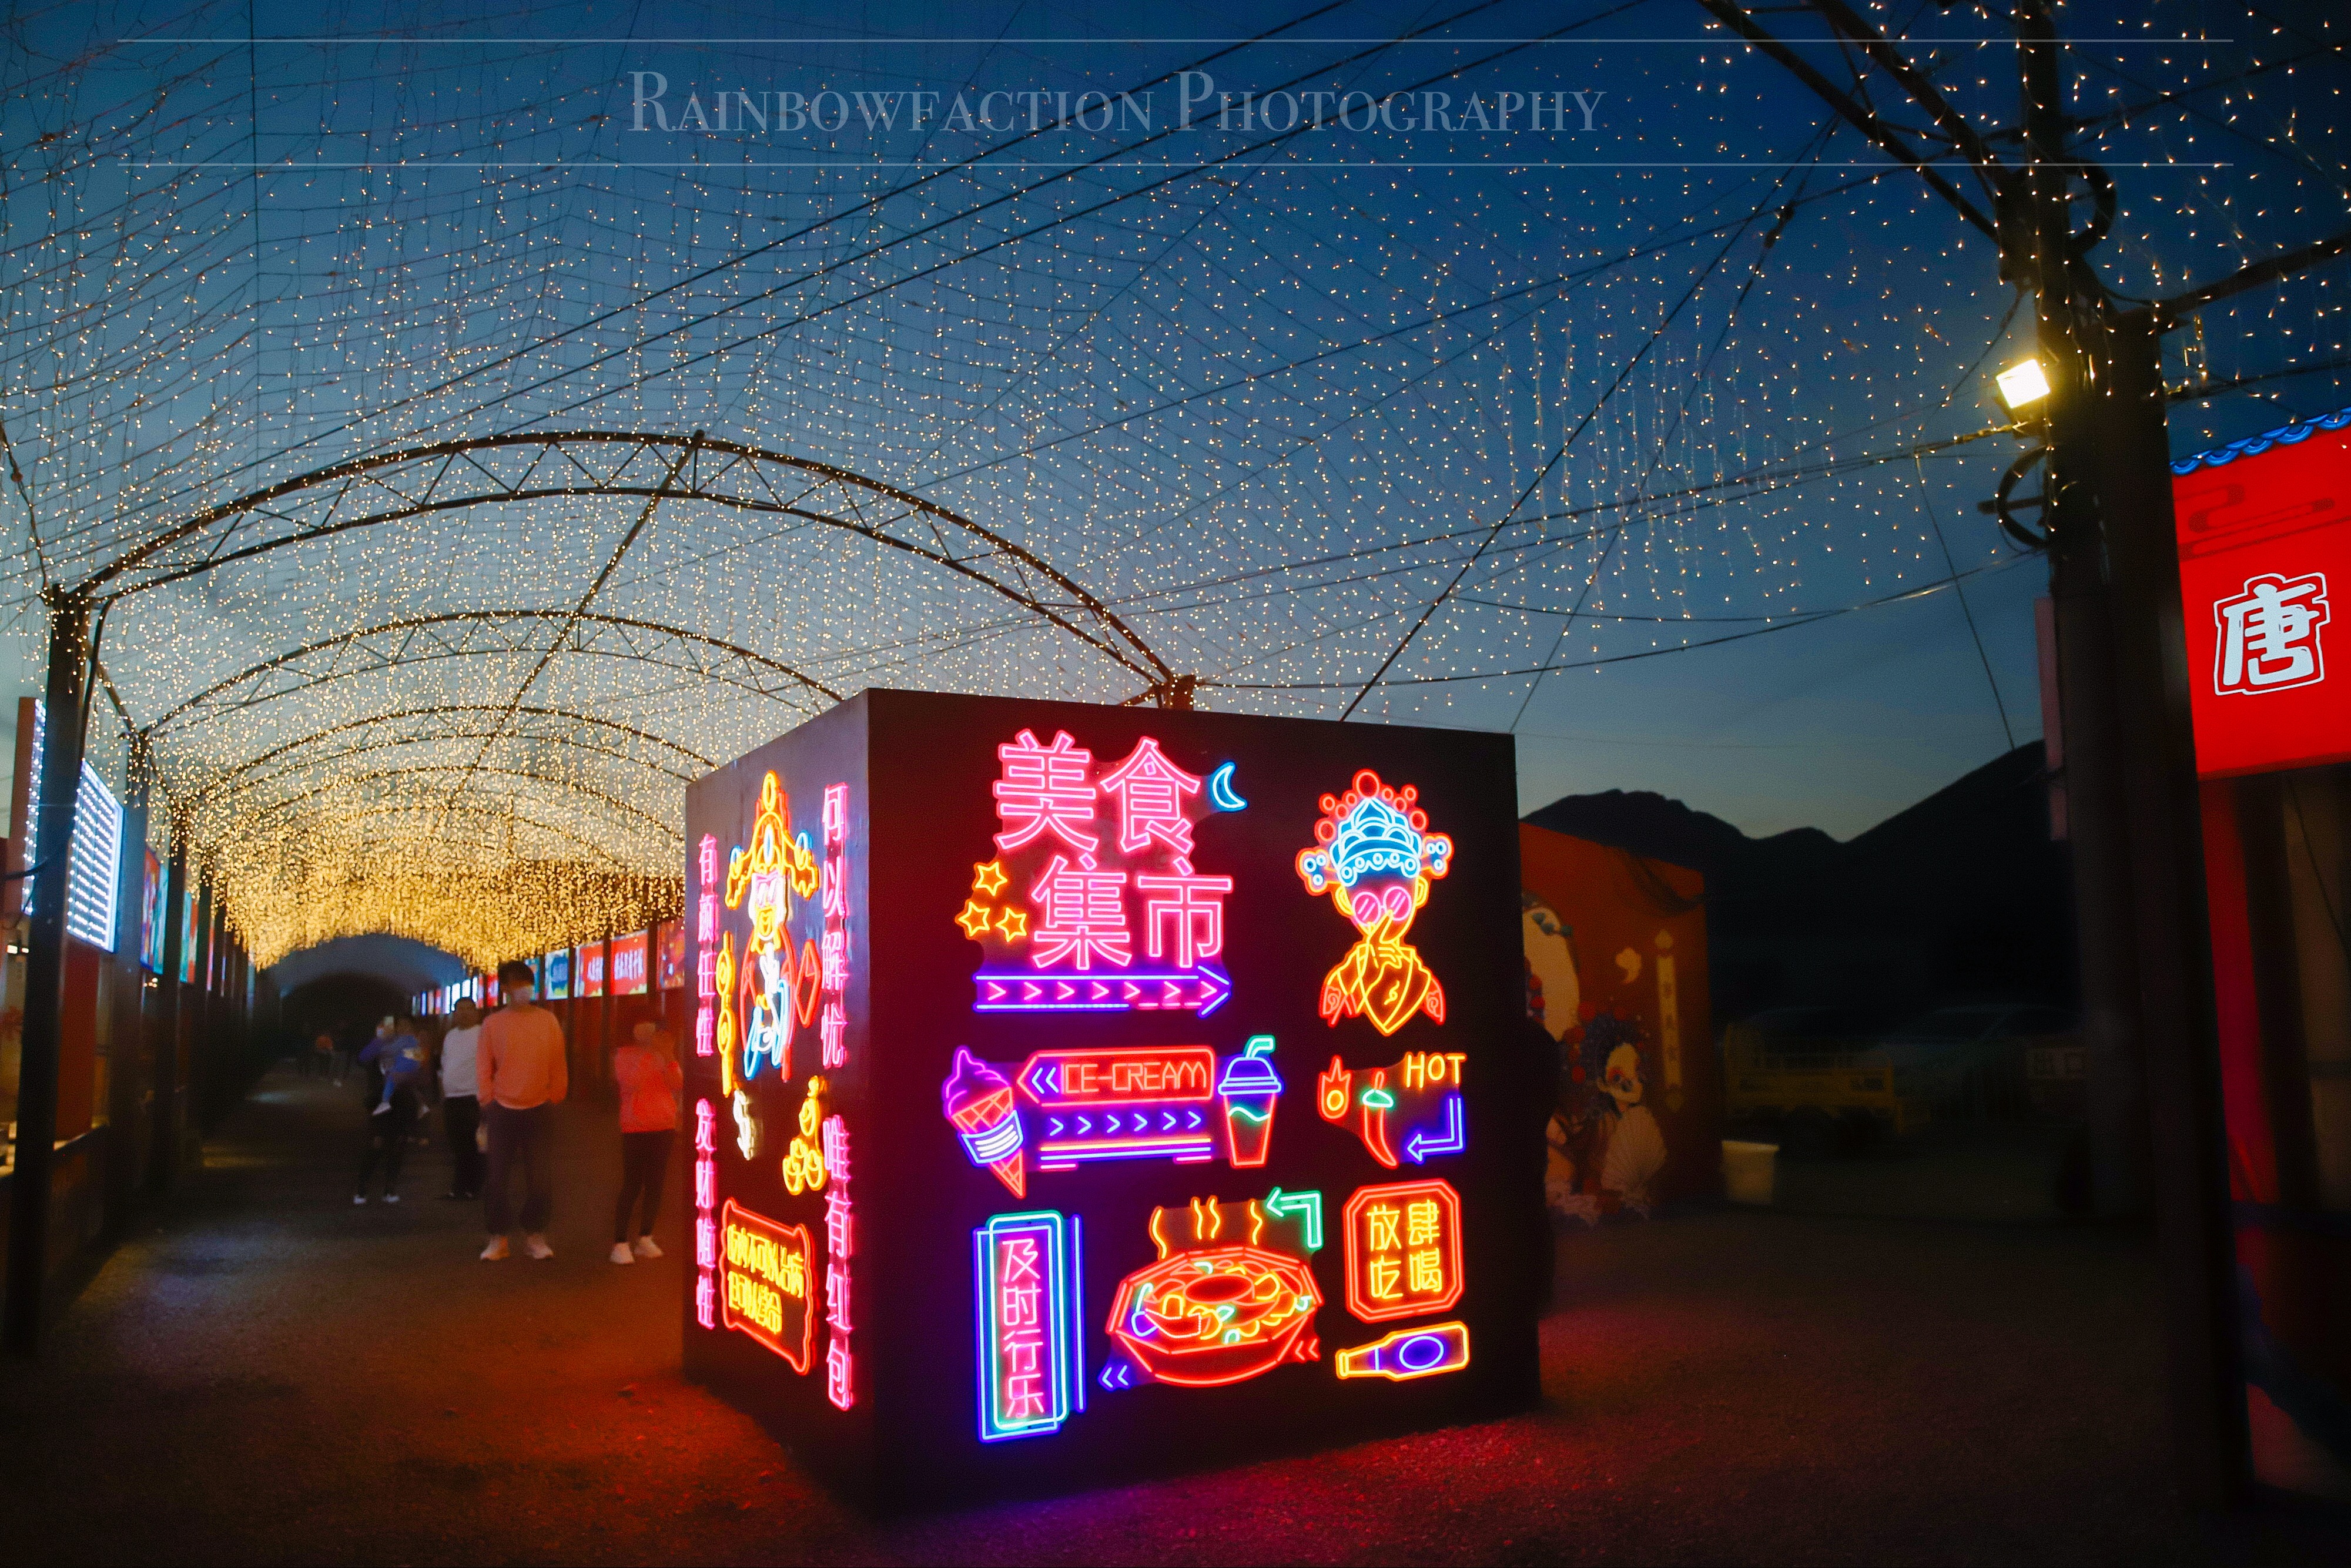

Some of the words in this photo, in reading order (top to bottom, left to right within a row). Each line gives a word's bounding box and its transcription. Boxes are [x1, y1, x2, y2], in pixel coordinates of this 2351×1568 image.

[2221, 582, 2322, 688] 唐
[993, 729, 1201, 854] 美食
[696, 833, 718, 1057] 有颜任性
[820, 783, 849, 1068] 何以解忧
[1031, 853, 1233, 971] 集市
[1061, 1060, 1207, 1094] ICE-CREAM
[1405, 1053, 1467, 1088] HOT
[695, 1098, 716, 1330] 发财随性
[823, 1114, 852, 1411] 唯有红包
[1367, 1199, 1441, 1251] 放肆
[1369, 1247, 1443, 1300] 吃喝
[1002, 1238, 1044, 1419] 及时行乐
